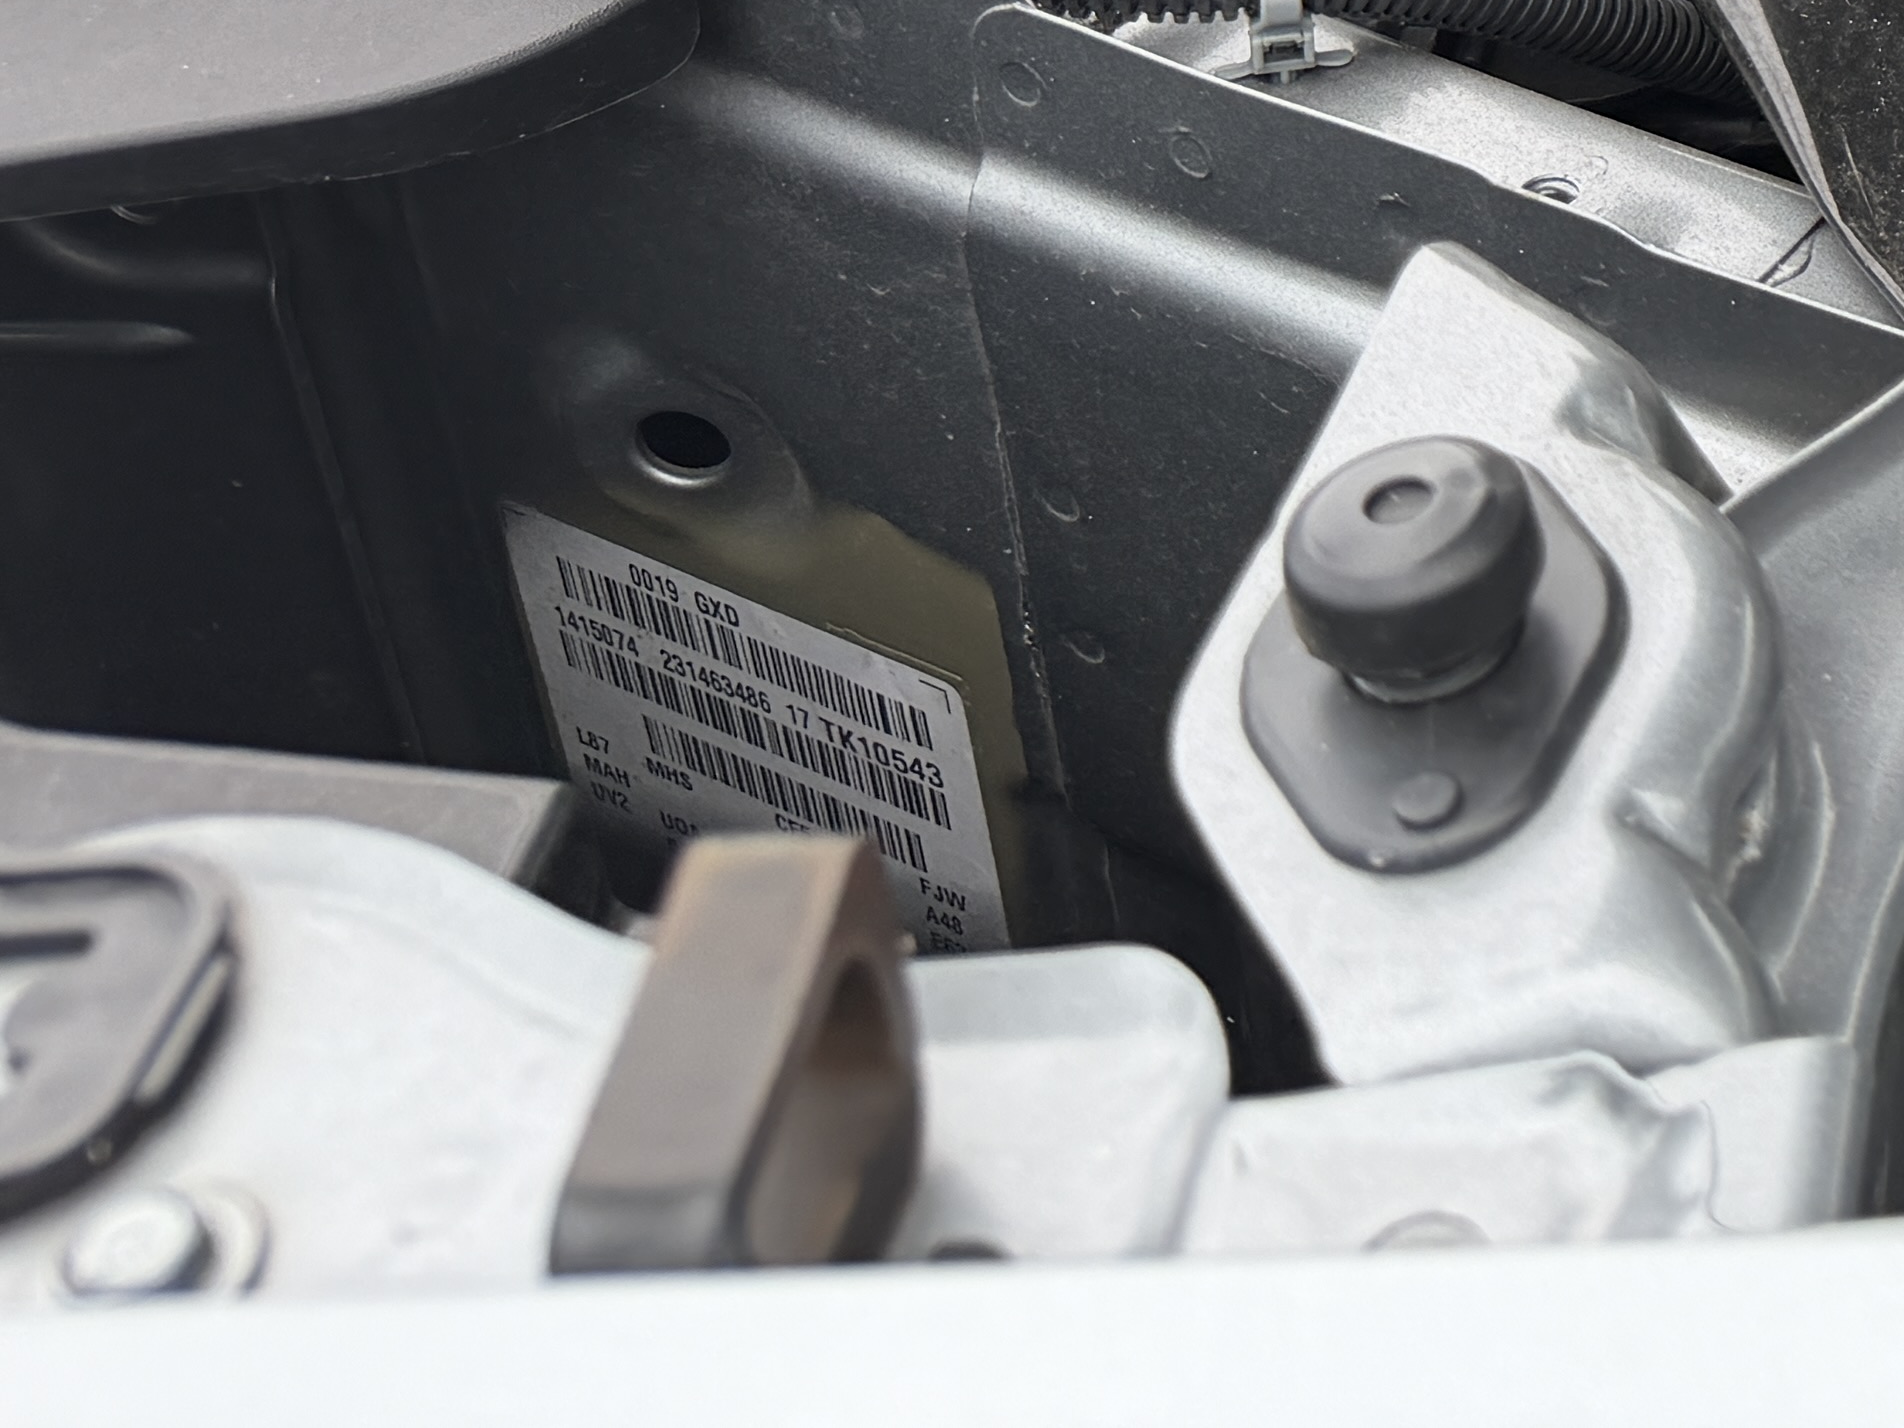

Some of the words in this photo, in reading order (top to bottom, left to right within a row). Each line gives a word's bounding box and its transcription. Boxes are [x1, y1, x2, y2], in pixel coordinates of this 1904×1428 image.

[628, 563, 679, 603] 0019
[694, 591, 740, 628] GXD
[555, 606, 639, 658] 1415074
[660, 649, 772, 714] 231463486
[786, 704, 809, 729] 17
[818, 716, 944, 788] TK10543
[645, 756, 693, 791] MHS
[919, 877, 966, 911] FJW
[926, 905, 963, 935] A48
